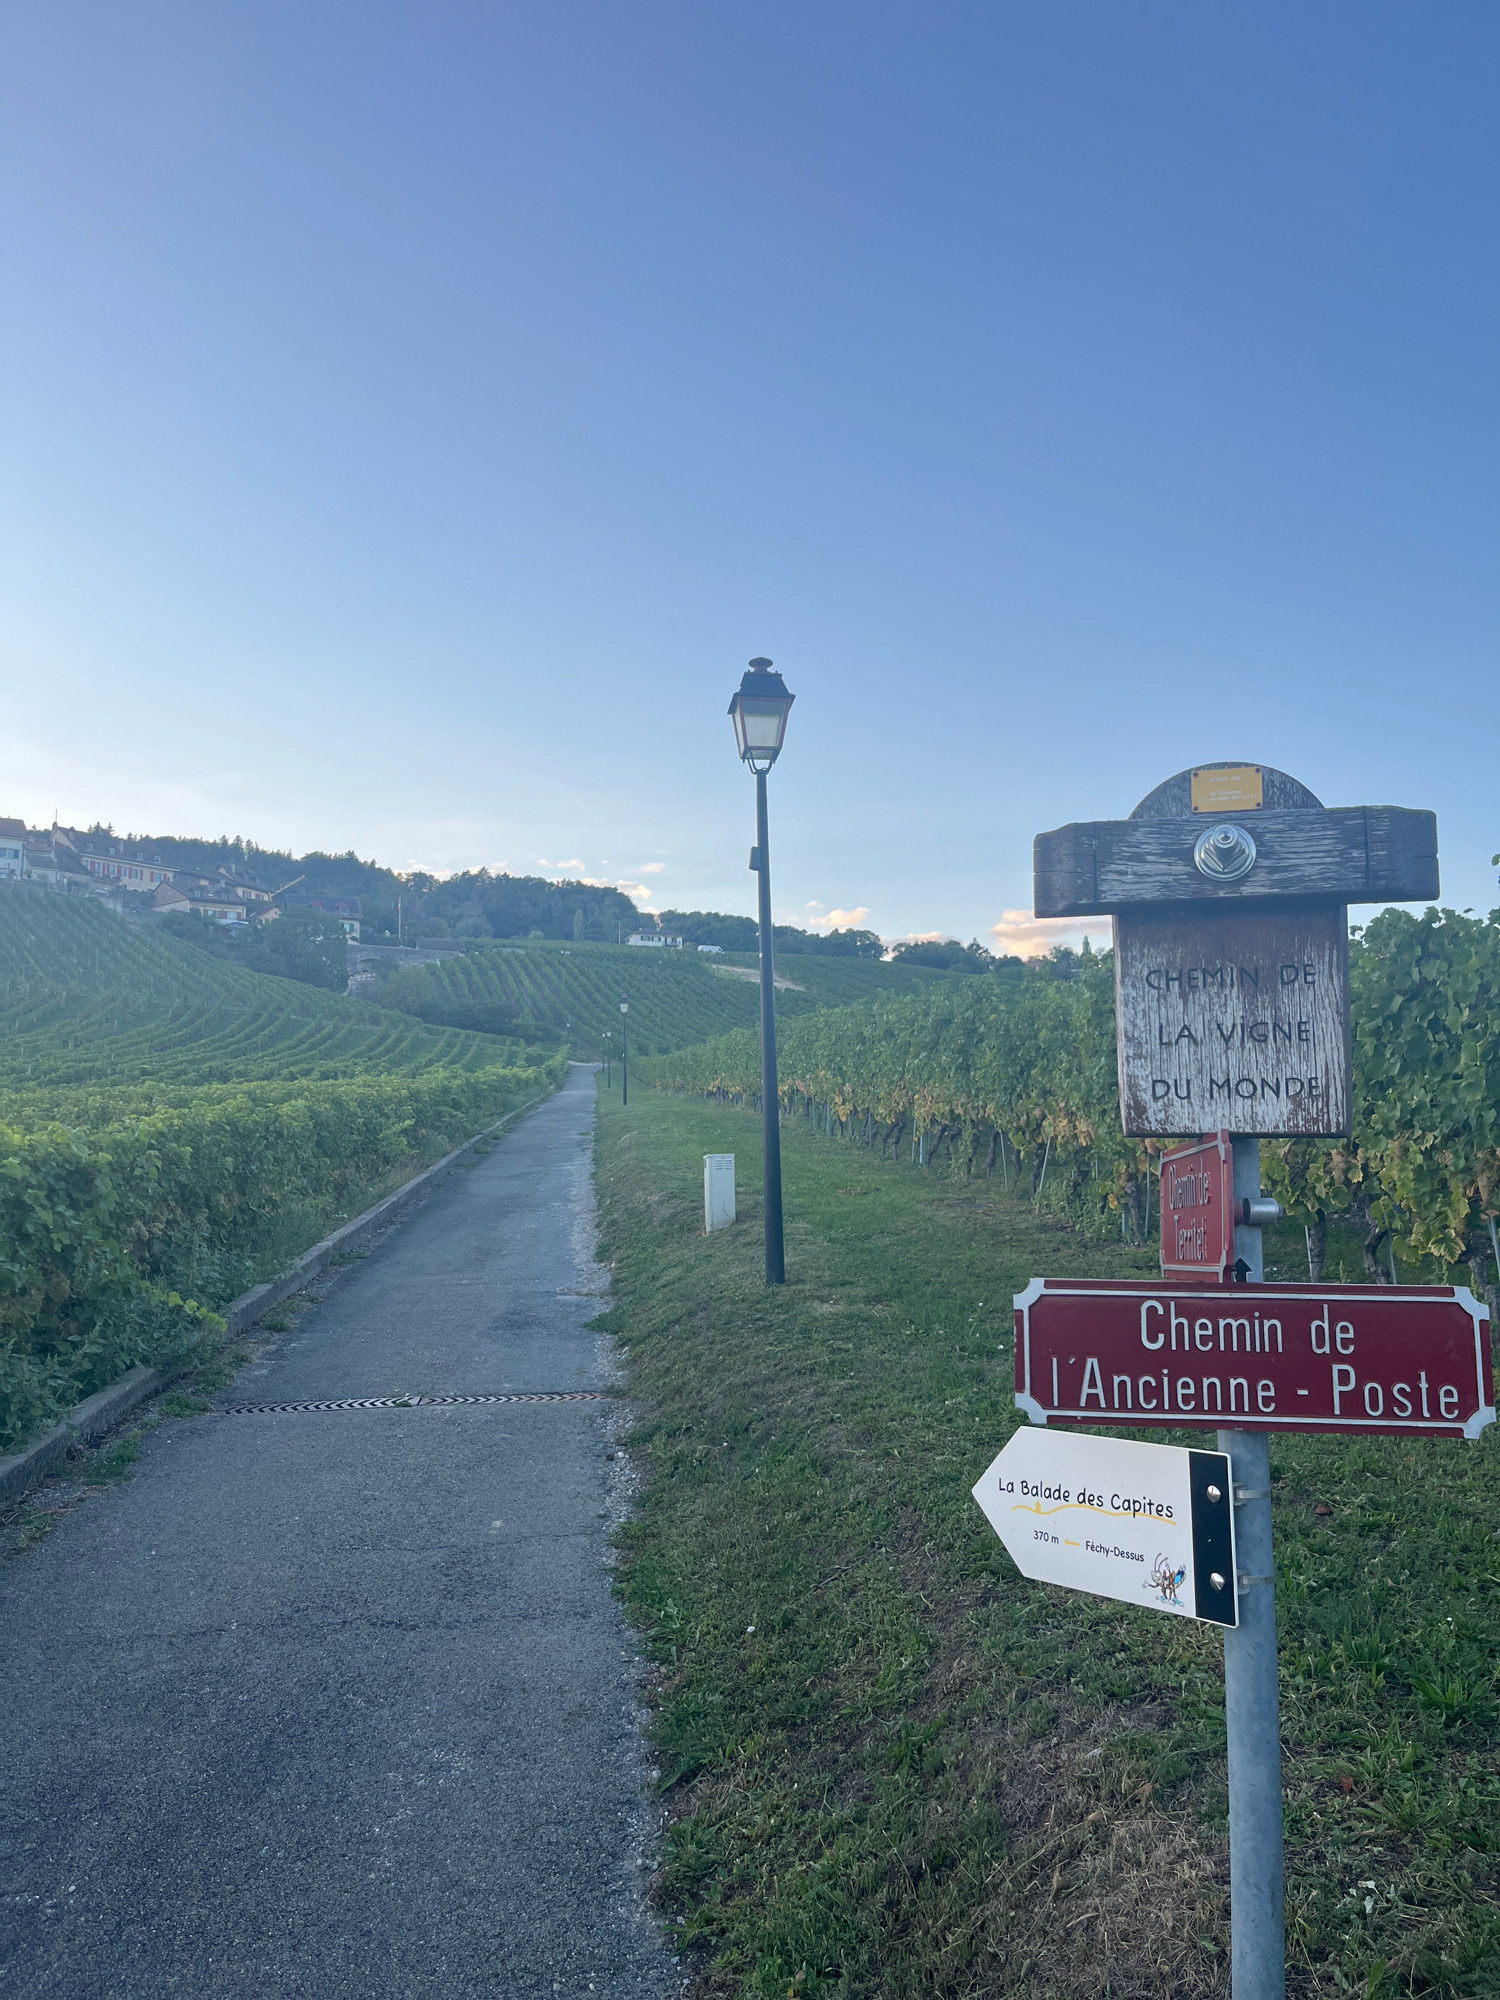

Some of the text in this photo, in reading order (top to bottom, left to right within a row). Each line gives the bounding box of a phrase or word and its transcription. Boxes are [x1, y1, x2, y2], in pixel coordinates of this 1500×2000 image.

[1146, 959, 1316, 991] CHEMIN DE
[1159, 1016, 1310, 1046] LA VIGNE
[1152, 1076, 1320, 1100] DU MONDE
[1168, 1155, 1210, 1210] Chemin de
[1140, 1299, 1355, 1355] Chemin de
[1331, 1363, 1460, 1419] Poste
[998, 1477, 1174, 1518] La Balade des Capites
[1033, 1530, 1059, 1544] 370 m
[1085, 1540, 1145, 1562] Féchy-Dessus
